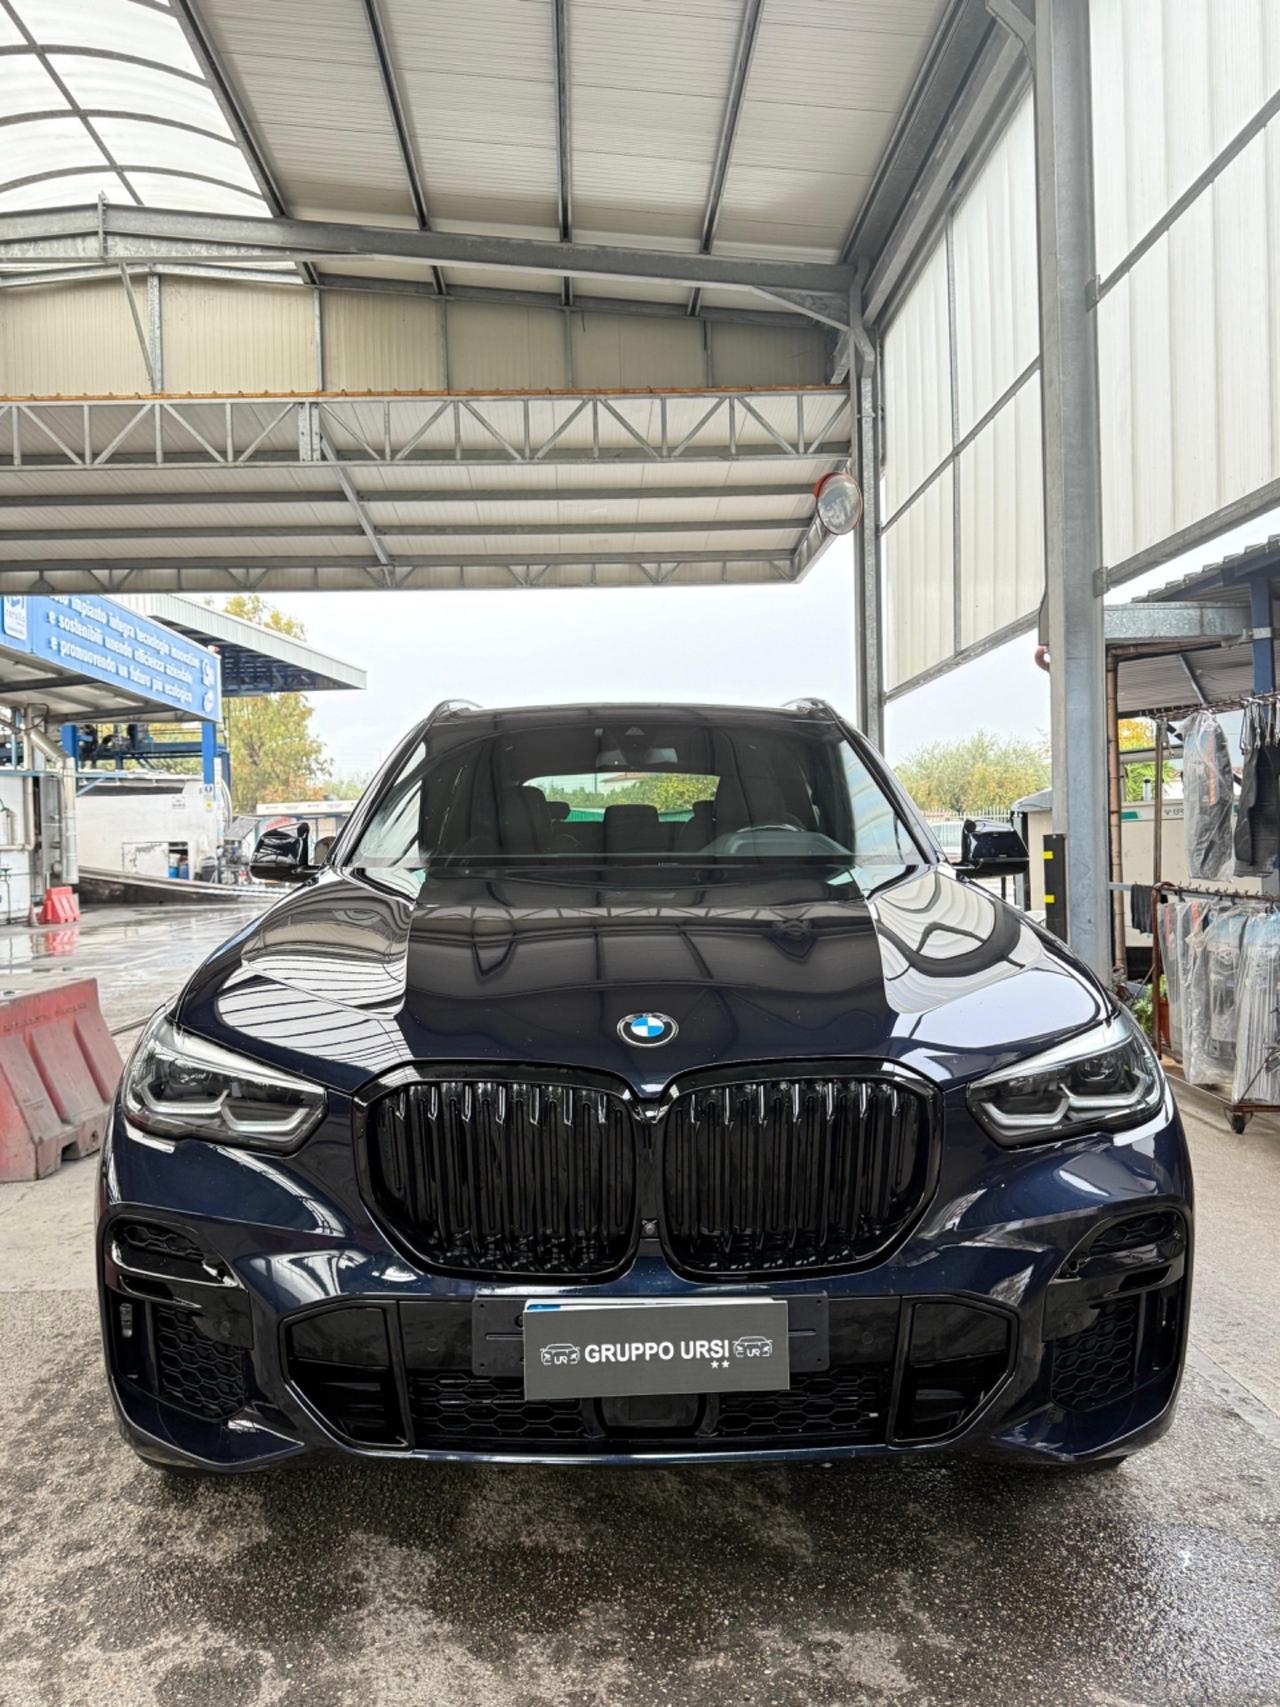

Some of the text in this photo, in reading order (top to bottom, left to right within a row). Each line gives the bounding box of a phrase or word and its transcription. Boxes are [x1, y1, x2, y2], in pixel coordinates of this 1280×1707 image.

[49, 610, 56, 625] e
[51, 635, 58, 650] e
[584, 1341, 674, 1363] GRUPPO
[680, 1339, 729, 1360] URSI
